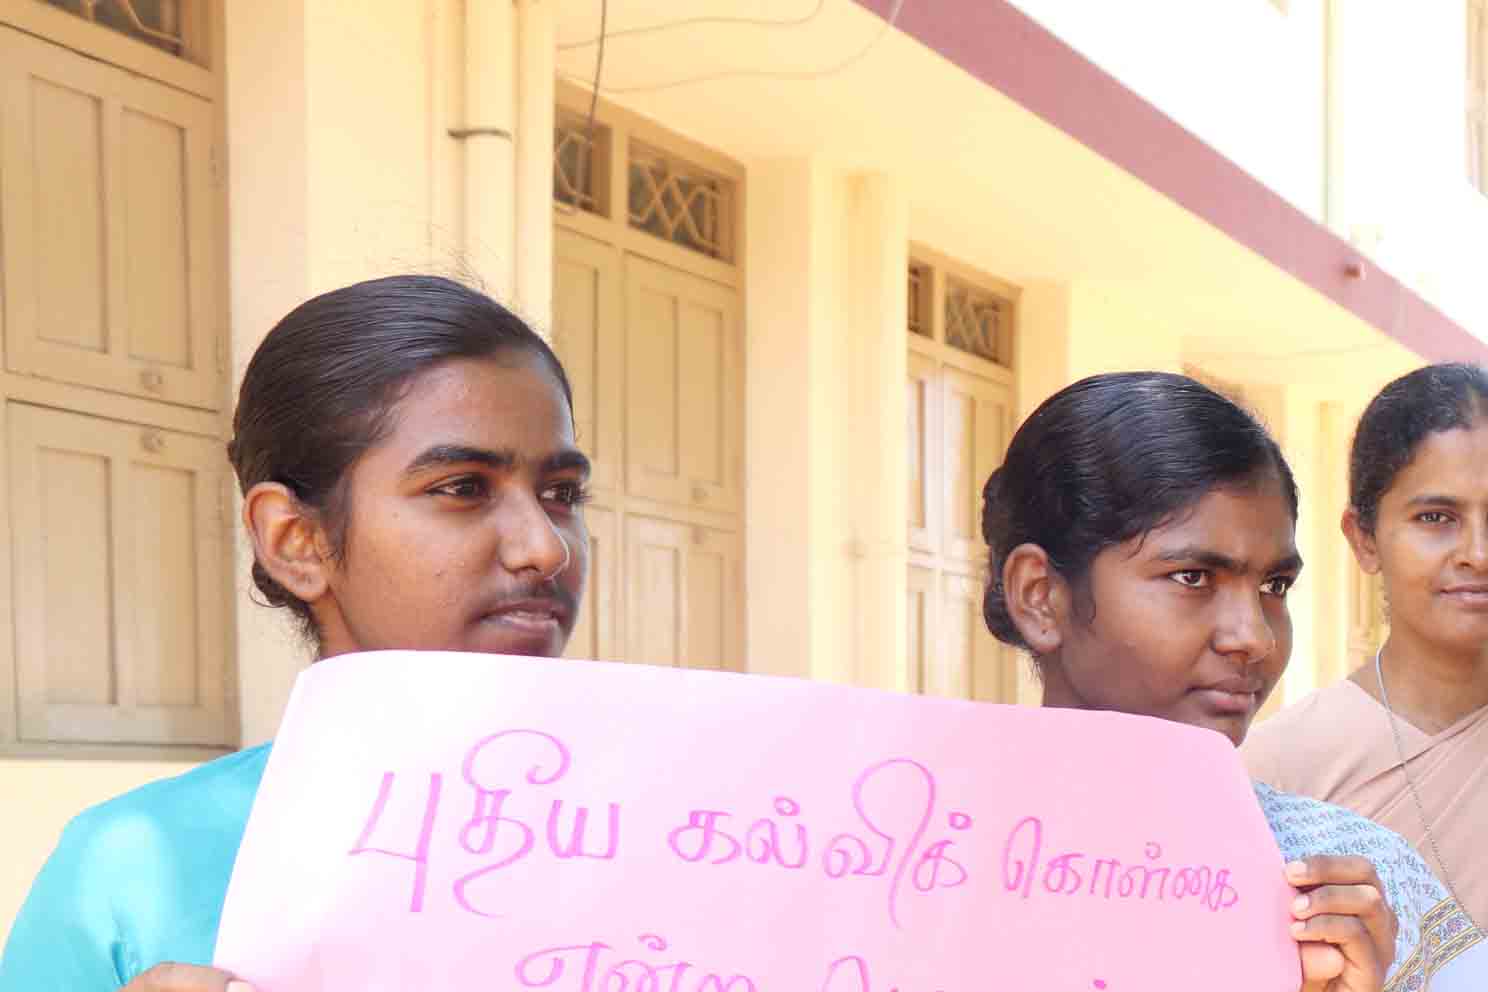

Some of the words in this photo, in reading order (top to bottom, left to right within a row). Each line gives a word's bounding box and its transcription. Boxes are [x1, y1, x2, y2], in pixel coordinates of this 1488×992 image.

[347, 728, 621, 919] புதிய
[667, 757, 972, 931] கல்விக்
[1001, 816, 1240, 912] கொள்கை
